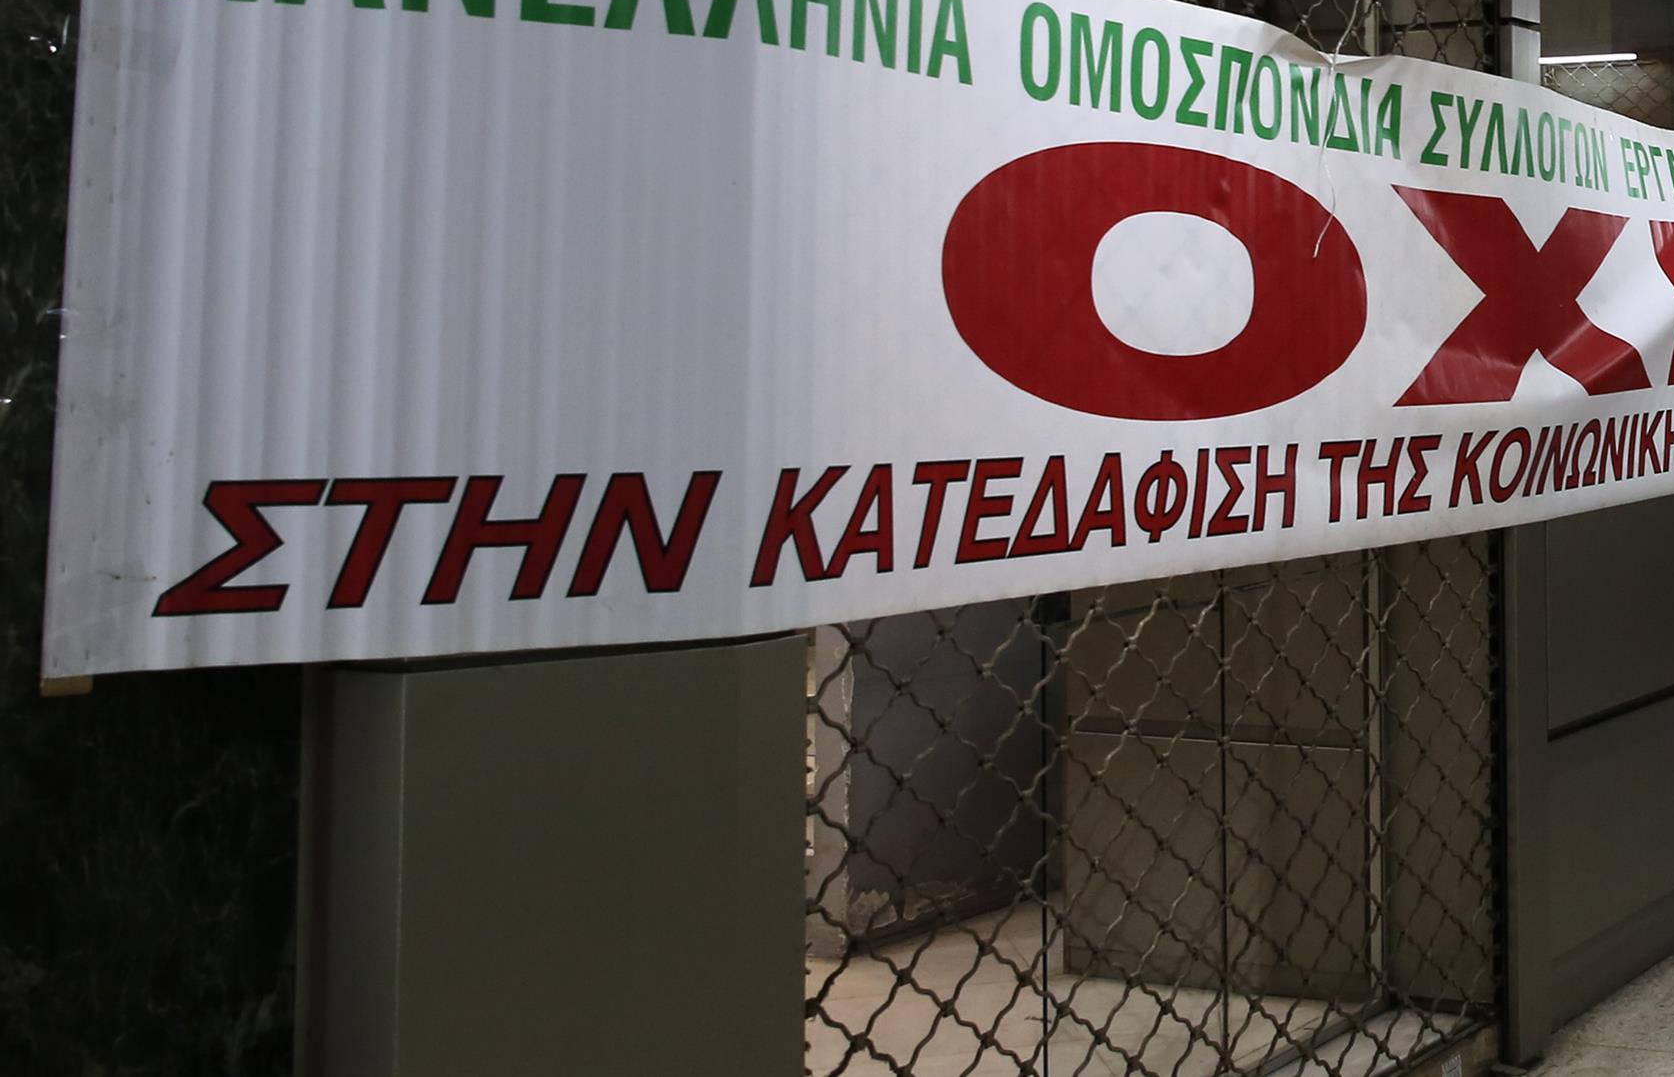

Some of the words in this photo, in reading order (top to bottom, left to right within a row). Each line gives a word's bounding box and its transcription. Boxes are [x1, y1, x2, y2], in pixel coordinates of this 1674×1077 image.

[1020, 1, 1402, 161] ΟΜΟΣΠΟΝΔΙΑ
[1420, 91, 1609, 191] ΣΥΛΛΟΓΩΝ
[152, 470, 722, 618] ΣΤΗΝ
[749, 443, 1299, 588] ΚΑΤΕΔΑΦΙΣΗ
[1317, 434, 1442, 523] ΤΗΣ
